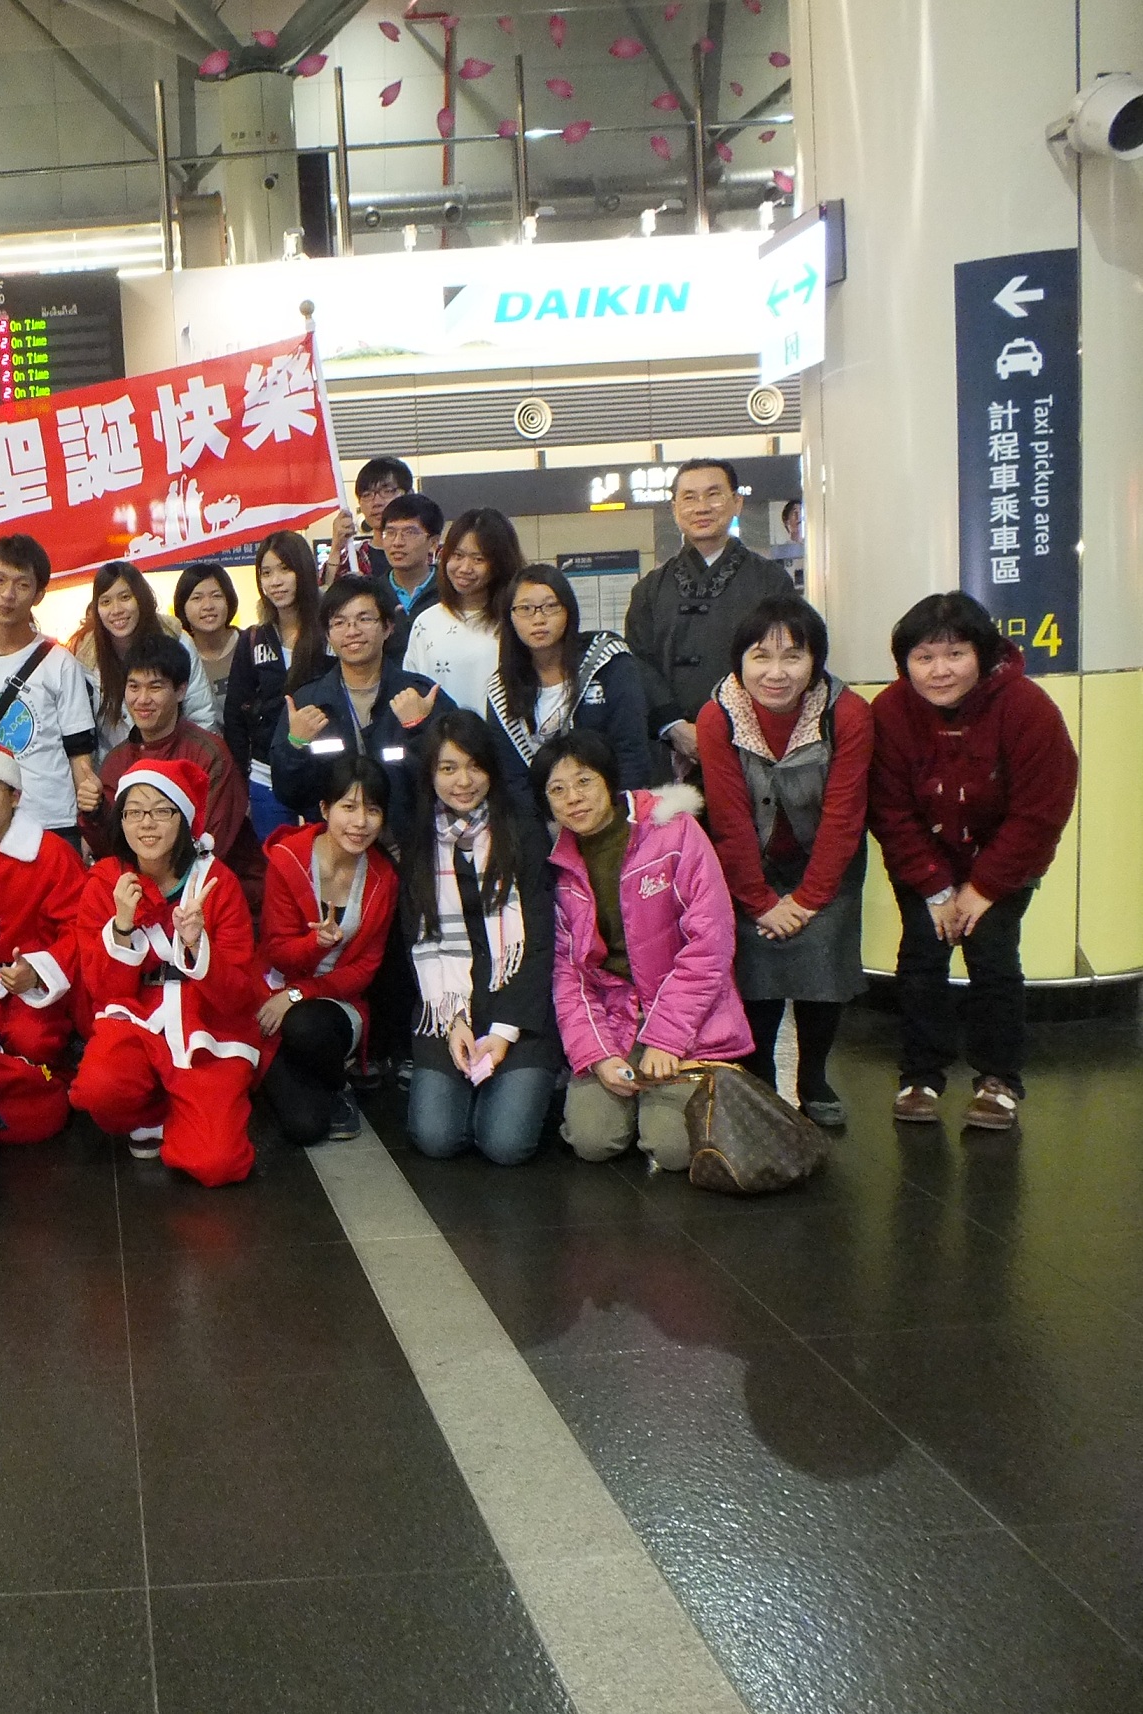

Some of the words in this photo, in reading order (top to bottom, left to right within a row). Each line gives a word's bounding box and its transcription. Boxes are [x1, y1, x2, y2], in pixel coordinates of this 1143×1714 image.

[494, 281, 691, 323] DAIKIN
[0, 321, 7, 332] 2
[10, 320, 22, 332] On
[24, 319, 46, 331] Time
[0, 337, 8, 349] 2
[11, 337, 23, 349] On
[25, 336, 47, 348] Time
[1, 354, 9, 365] 2
[12, 354, 24, 365] On
[26, 352, 48, 364] Time
[2, 371, 10, 382] 2
[13, 370, 25, 382] On
[28, 369, 49, 381] Time
[4, 387, 12, 399] 2
[14, 387, 26, 399] On
[29, 386, 50, 398] Time
[1033, 394, 1054, 435] Taxi
[987, 399, 1021, 585] 計程車乘車區
[1029, 440, 1055, 508] pickup
[1034, 513, 1050, 556] area
[1032, 612, 1062, 657] 4
